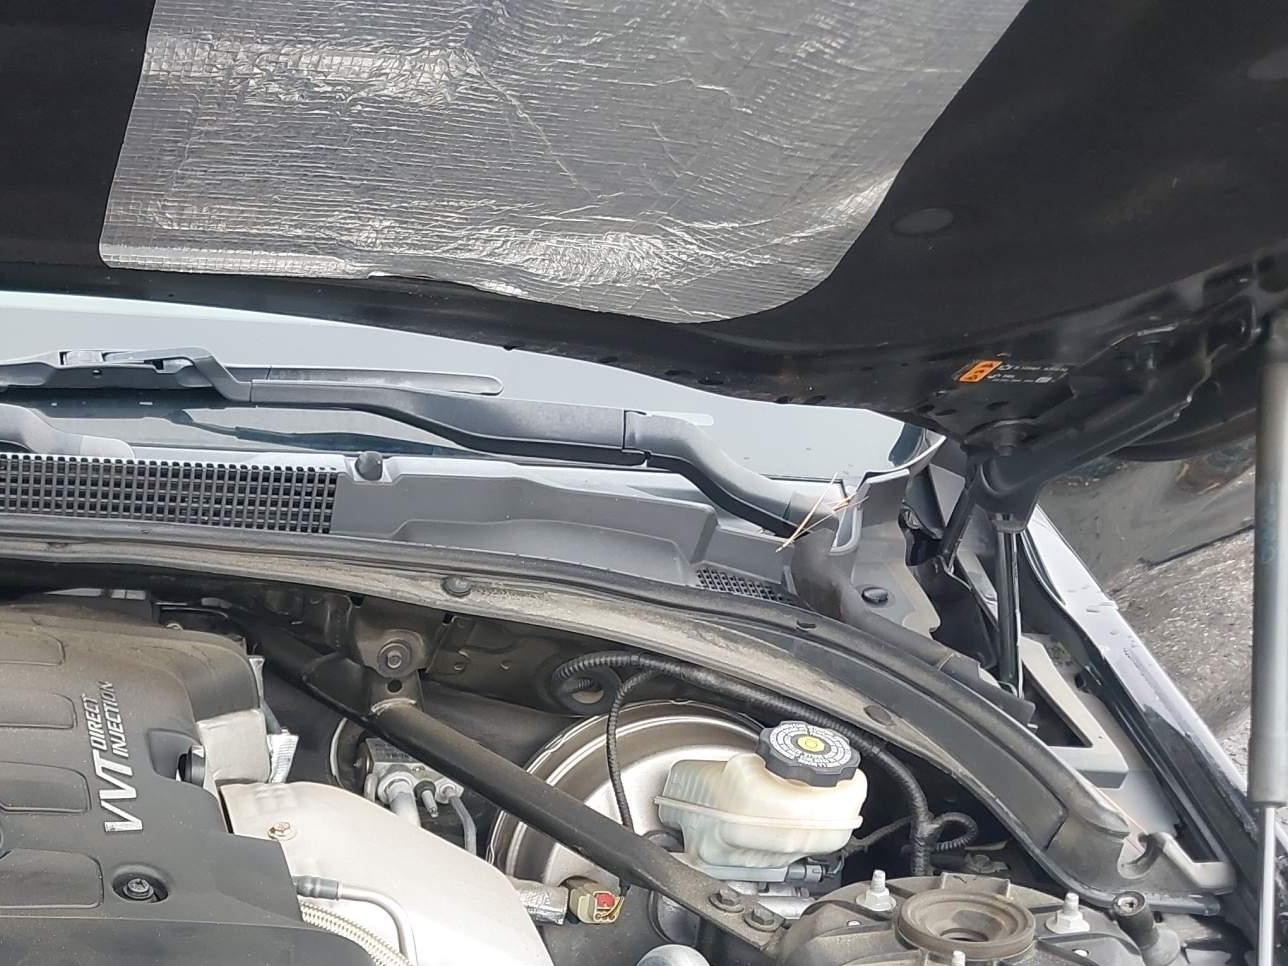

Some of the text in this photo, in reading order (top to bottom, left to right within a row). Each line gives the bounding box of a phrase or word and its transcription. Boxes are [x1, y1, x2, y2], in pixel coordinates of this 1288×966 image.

[81, 693, 108, 751] DIRECT
[98, 681, 129, 758] INJECTION
[93, 749, 143, 832] VVT
